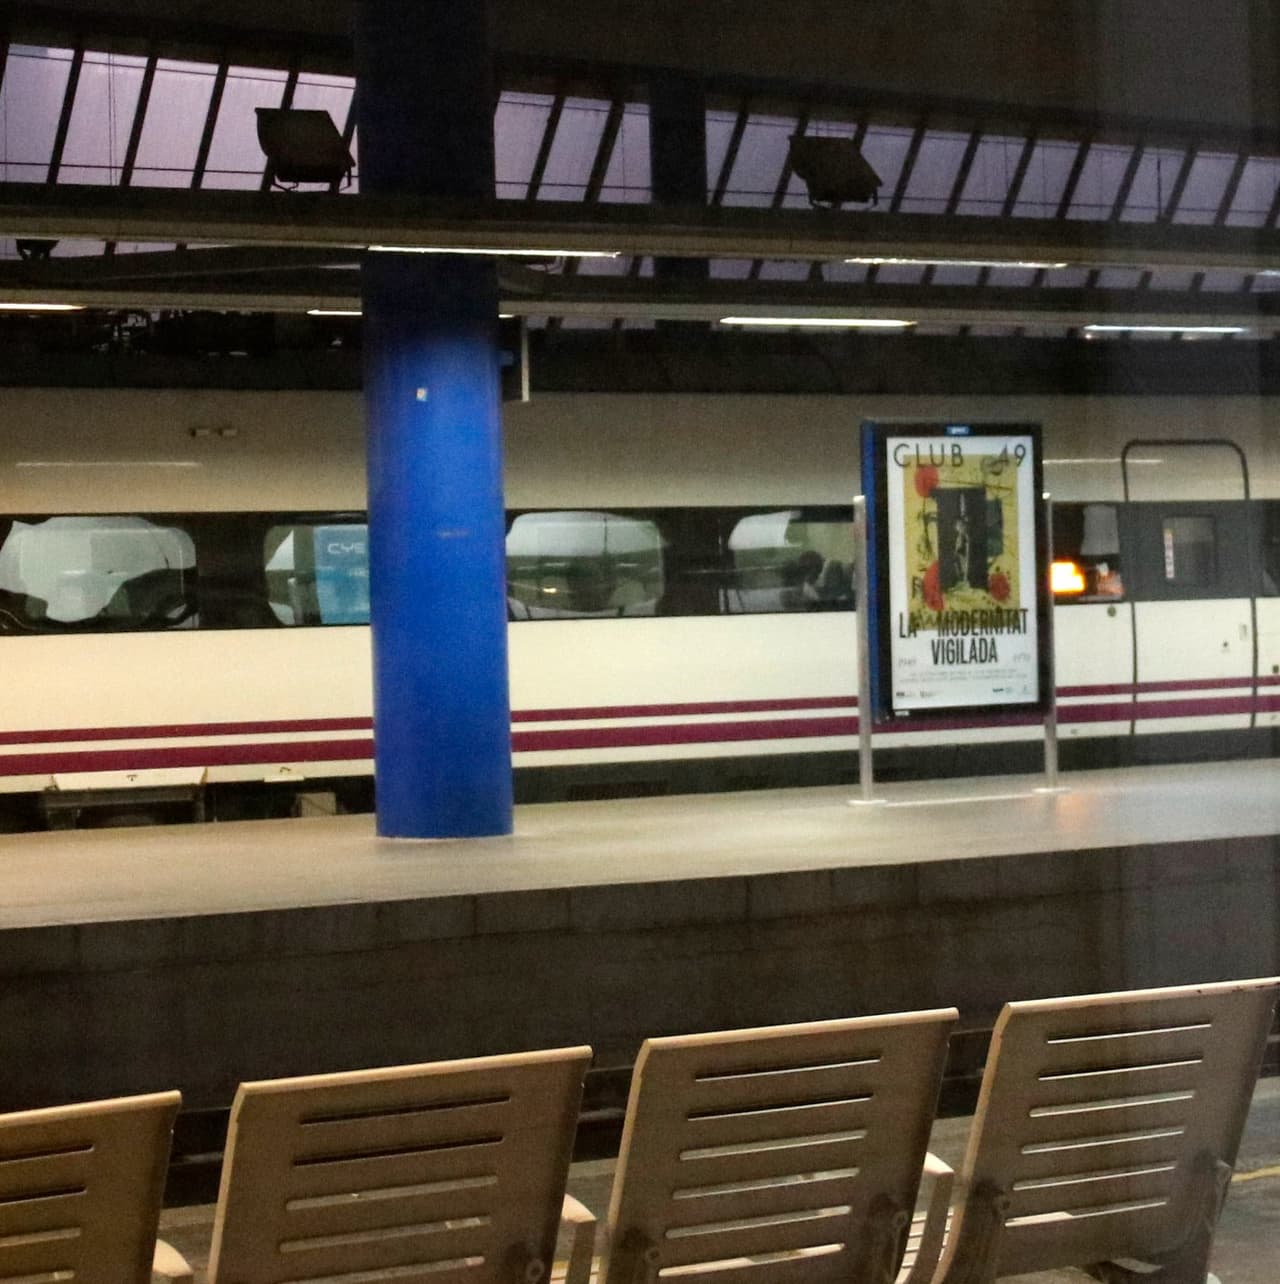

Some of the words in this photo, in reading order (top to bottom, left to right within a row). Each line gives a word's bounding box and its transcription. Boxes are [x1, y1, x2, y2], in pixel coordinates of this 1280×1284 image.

[893, 443, 964, 468] CLUB
[899, 611, 918, 638] LA
[937, 607, 1028, 637] MODERNITAT
[931, 637, 998, 665] VIGILADA
